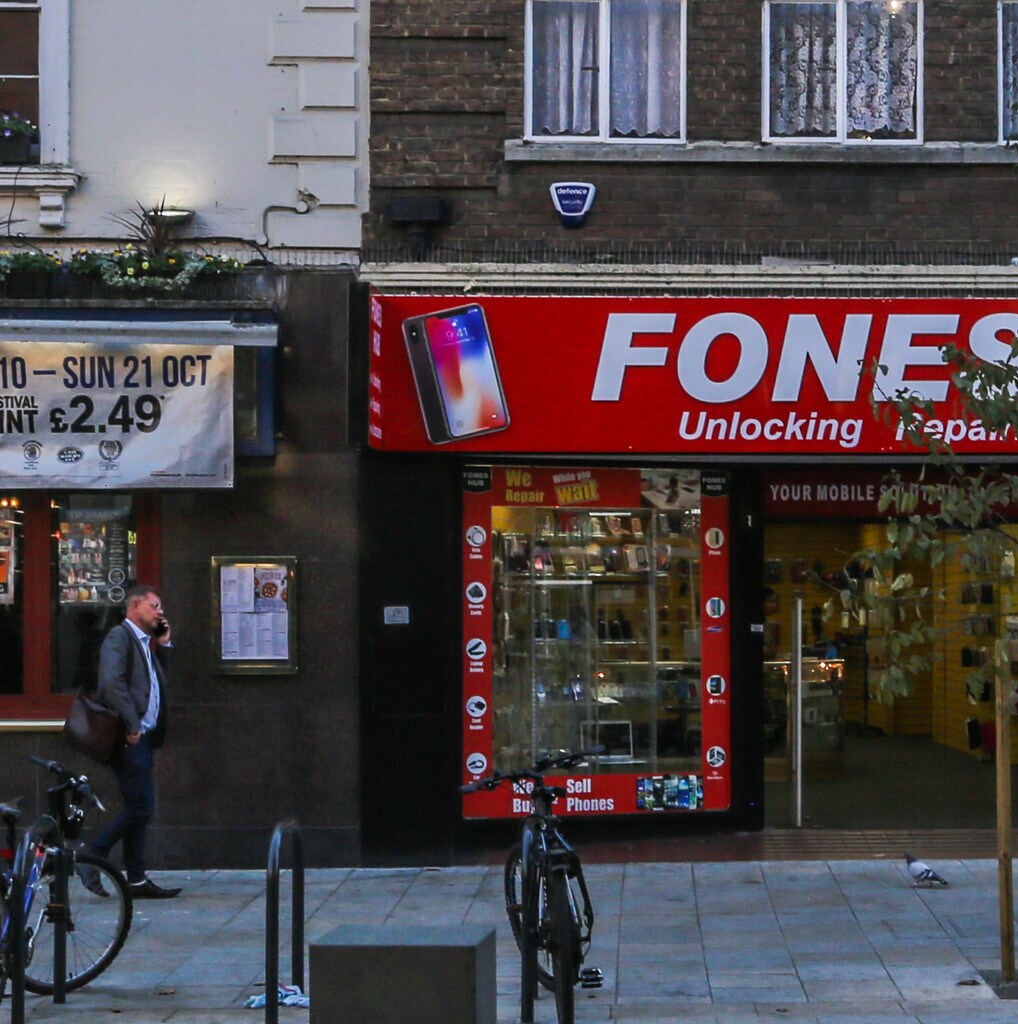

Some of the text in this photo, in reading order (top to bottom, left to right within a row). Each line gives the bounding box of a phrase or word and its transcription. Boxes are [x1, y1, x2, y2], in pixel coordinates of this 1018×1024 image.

[0, 356, 27, 389] 10
[63, 356, 115, 388] SUN
[124, 356, 152, 388] 21
[163, 355, 212, 387] OCT
[678, 411, 864, 448] Unlocking
[505, 469, 532, 487] We
[552, 471, 592, 483] While you
[505, 489, 544, 504] Repair
[557, 480, 599, 503] wait
[770, 484, 811, 501] YOUR
[816, 484, 874, 501] MOBILE
[880, 483, 957, 501] SOUT
[566, 778, 591, 793] Sell
[566, 797, 615, 813] Phones
